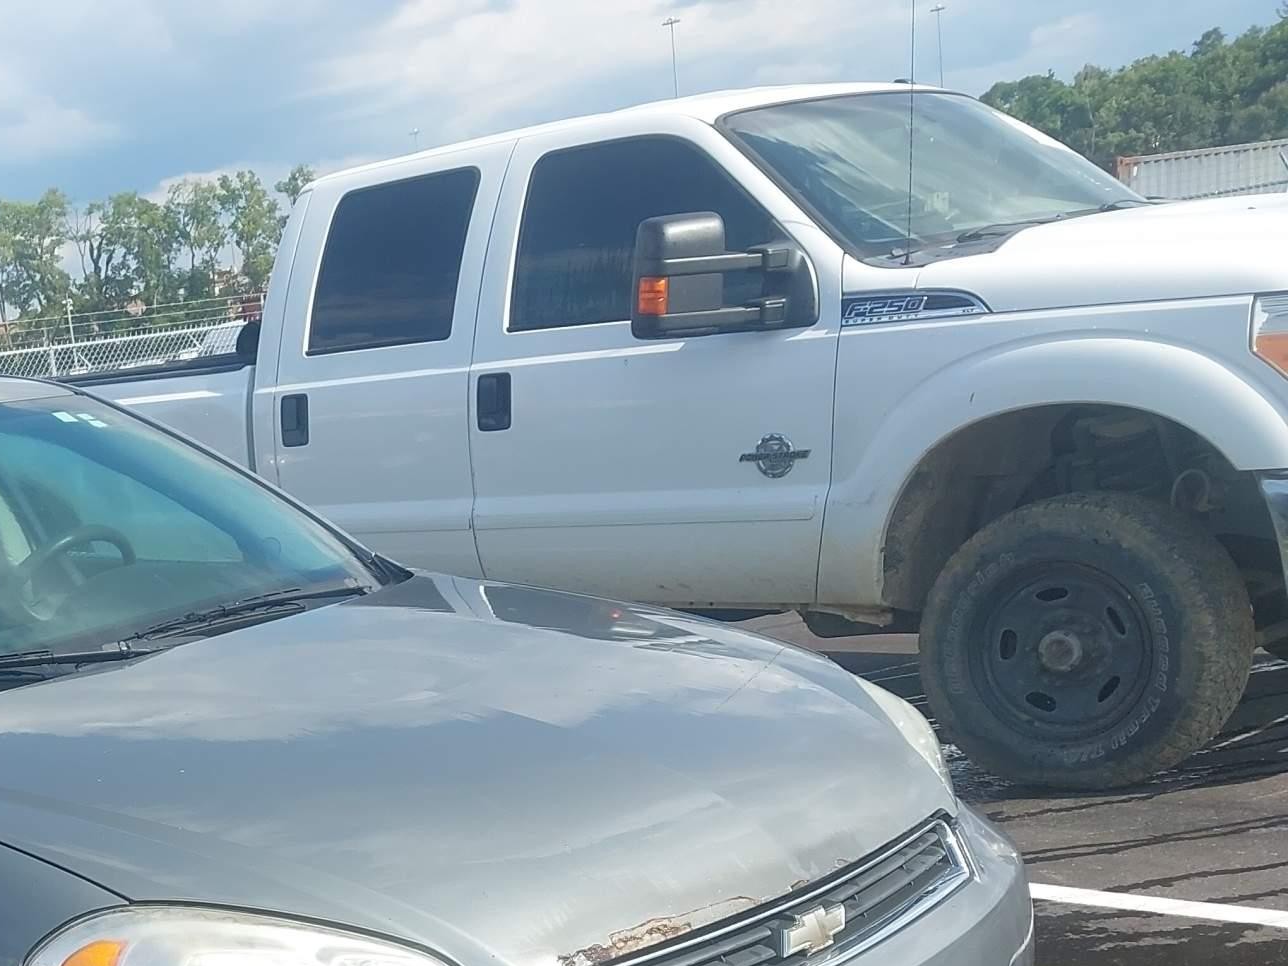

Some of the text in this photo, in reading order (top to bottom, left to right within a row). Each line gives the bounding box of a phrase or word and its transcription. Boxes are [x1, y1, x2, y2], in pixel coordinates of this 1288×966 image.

[844, 296, 928, 319] F-250
[844, 313, 920, 324] SUPER DUTY
